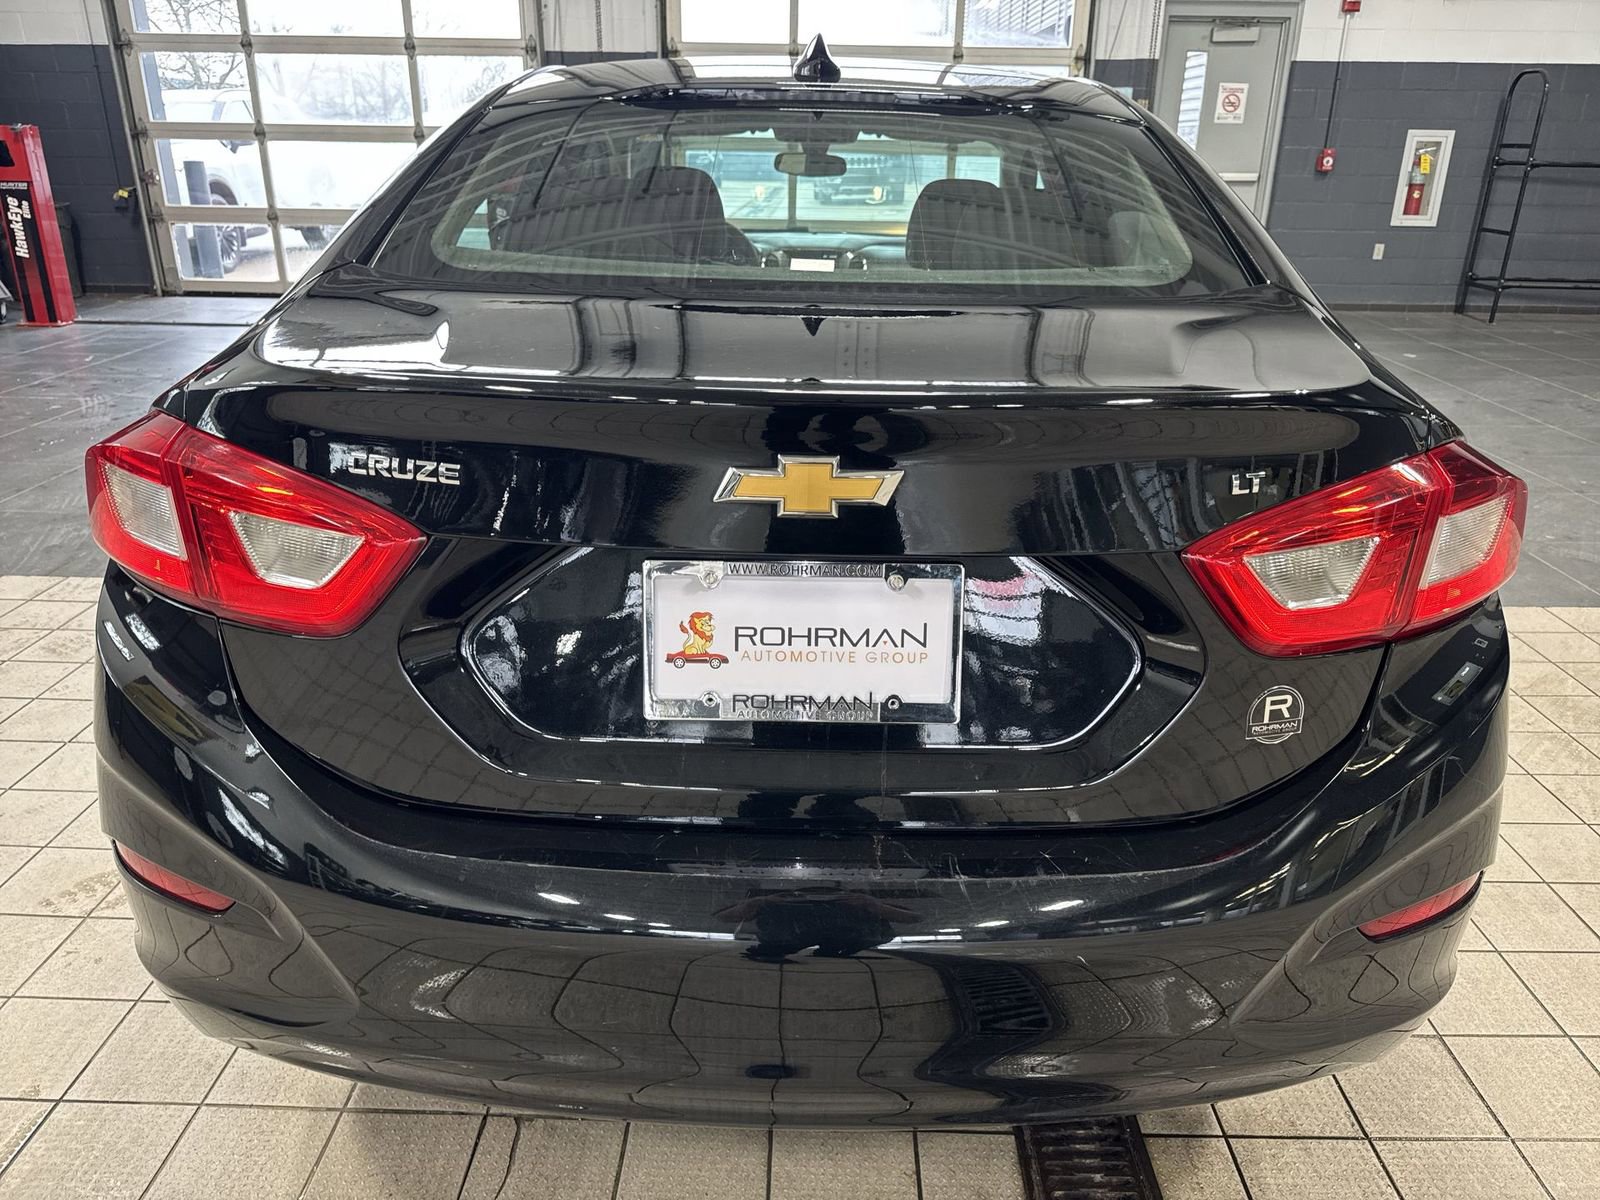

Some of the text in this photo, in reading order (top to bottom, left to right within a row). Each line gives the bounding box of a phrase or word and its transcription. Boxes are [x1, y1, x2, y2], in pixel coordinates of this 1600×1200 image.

[21, 200, 31, 219] Elite
[7, 196, 30, 258] HawkEye
[347, 451, 461, 485] CRUZE
[1231, 471, 1266, 495] LT
[729, 563, 881, 577] WWW.ROHRMAN.COM
[734, 622, 928, 652] ROHRMAN
[741, 650, 928, 664] AUTOMOTIVE GROUP
[732, 691, 873, 712] ROHRMAN
[1263, 694, 1293, 724] R
[1252, 720, 1297, 733] ROHRMAN
